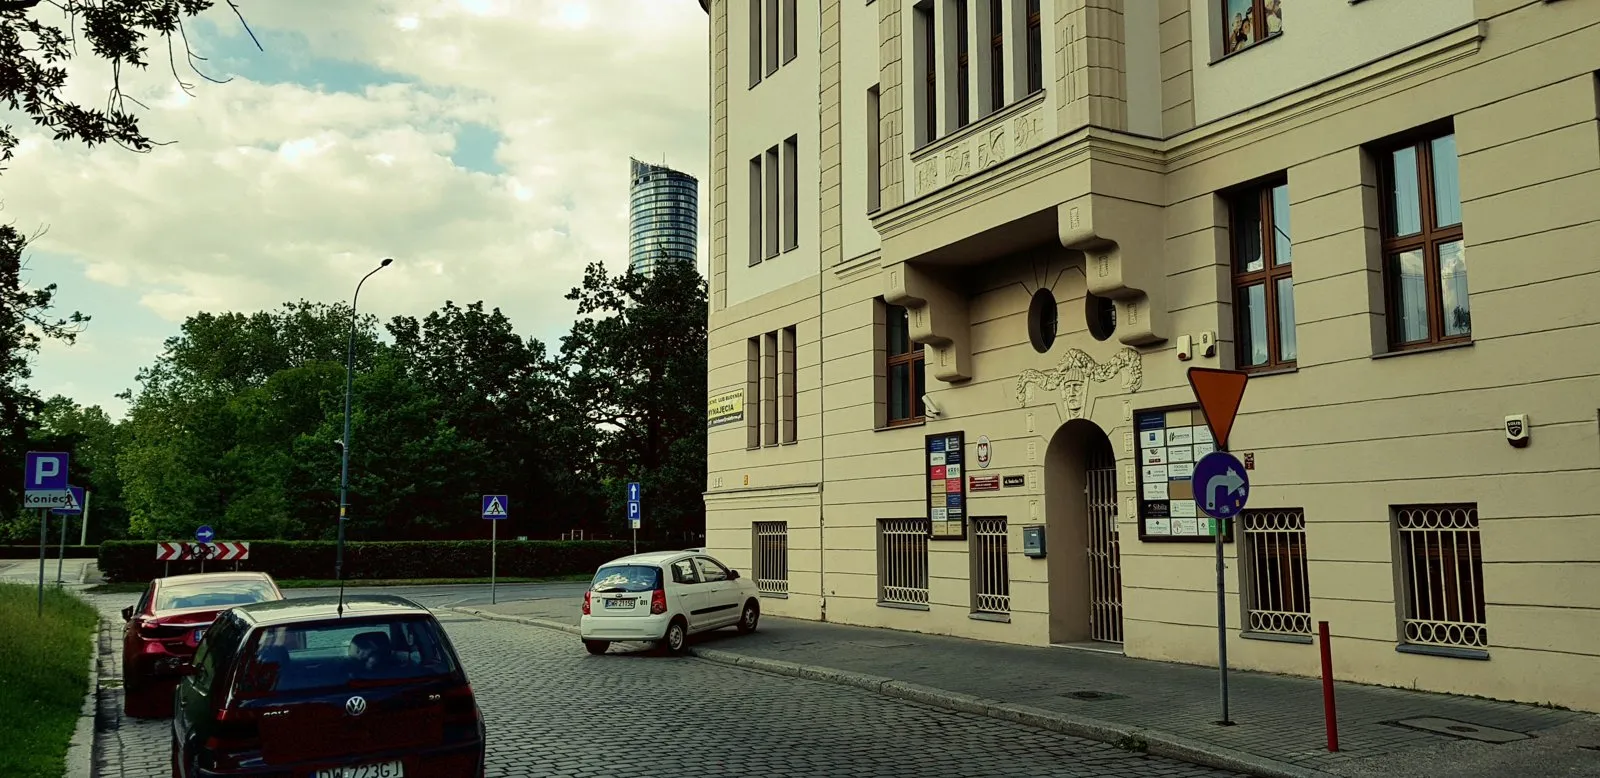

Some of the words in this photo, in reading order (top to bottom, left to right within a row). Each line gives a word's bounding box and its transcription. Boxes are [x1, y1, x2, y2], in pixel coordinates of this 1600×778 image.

[35, 456, 59, 485] P
[25, 493, 66, 504] Koniec
[630, 502, 638, 517] P
[349, 761, 399, 778] 723GJ
